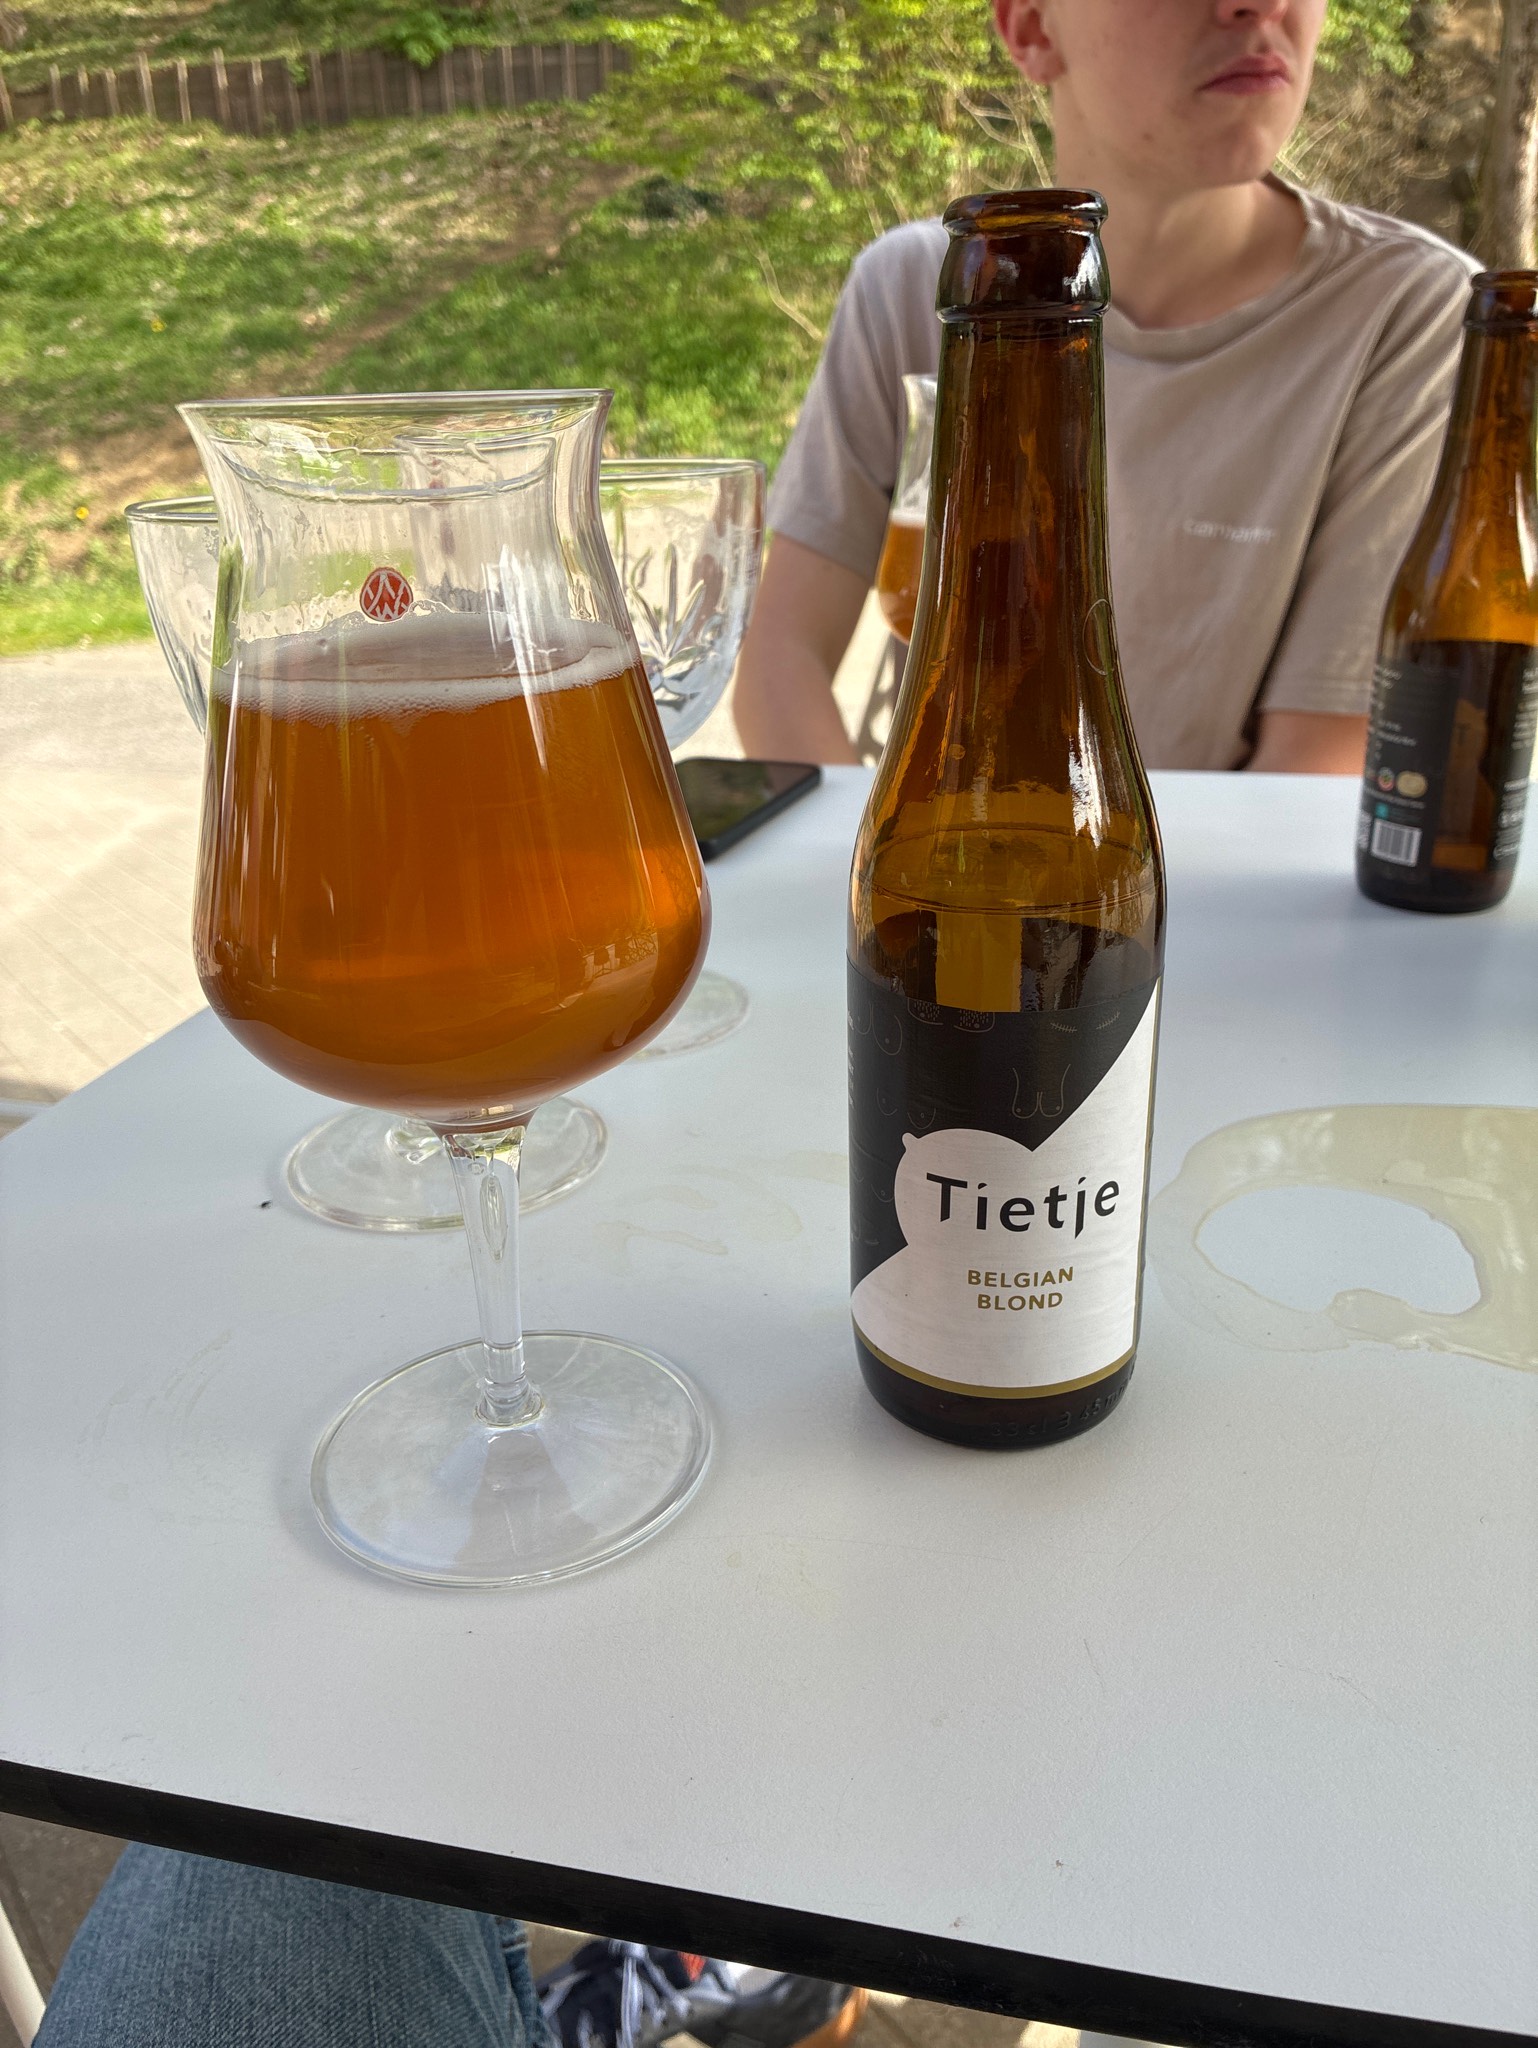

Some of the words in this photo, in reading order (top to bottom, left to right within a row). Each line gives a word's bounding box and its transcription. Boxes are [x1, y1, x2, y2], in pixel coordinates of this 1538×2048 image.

[927, 1174, 1120, 1239] Tietje
[967, 1266, 1074, 1289] BELGIAN
[977, 1292, 1064, 1311] BLOND
